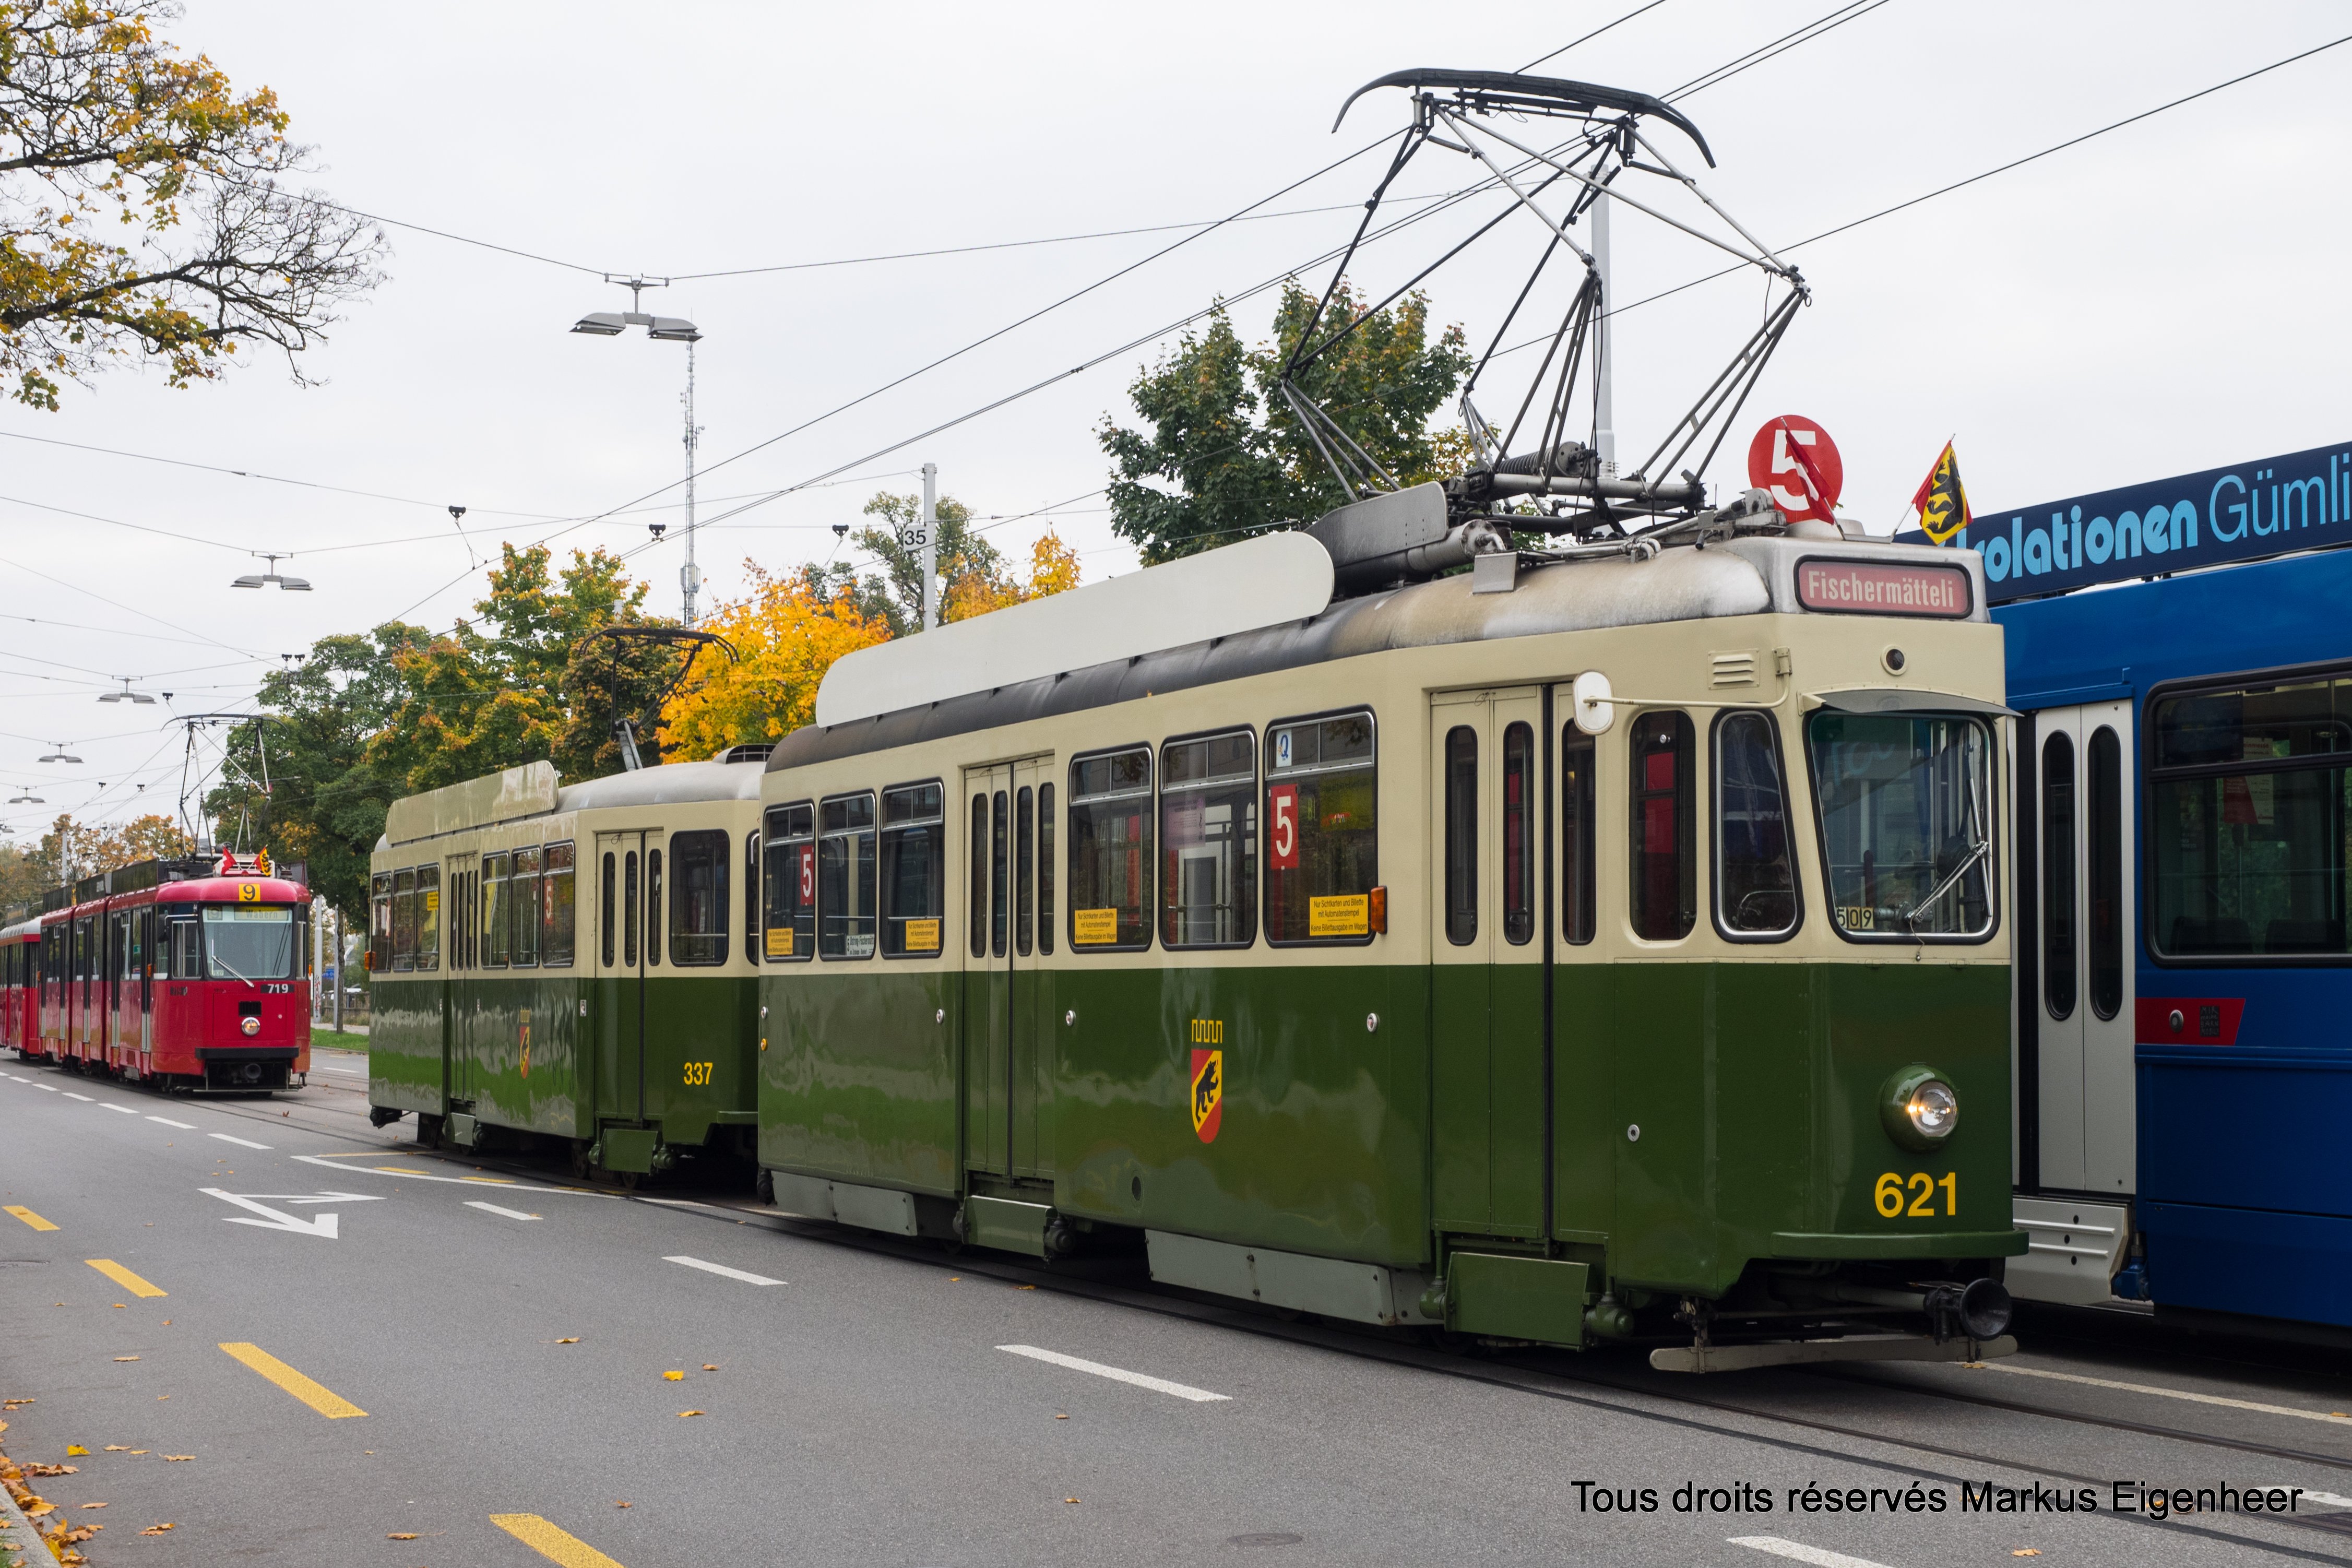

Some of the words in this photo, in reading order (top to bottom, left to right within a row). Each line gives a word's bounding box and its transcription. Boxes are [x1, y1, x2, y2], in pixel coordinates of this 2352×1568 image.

[1770, 430, 1820, 510] 5
[2210, 453, 2350, 542] Gümli
[905, 529, 926, 545] 35
[1809, 571, 1953, 607] Fischermätteli
[1276, 795, 1292, 857] 5
[803, 853, 811, 897] 5
[243, 885, 256, 900] 9
[546, 886, 551, 919] 5
[246, 910, 278, 919] Wabern
[267, 984, 288, 994] 719
[684, 1062, 713, 1085] 337
[1875, 1172, 1956, 1218] 621
